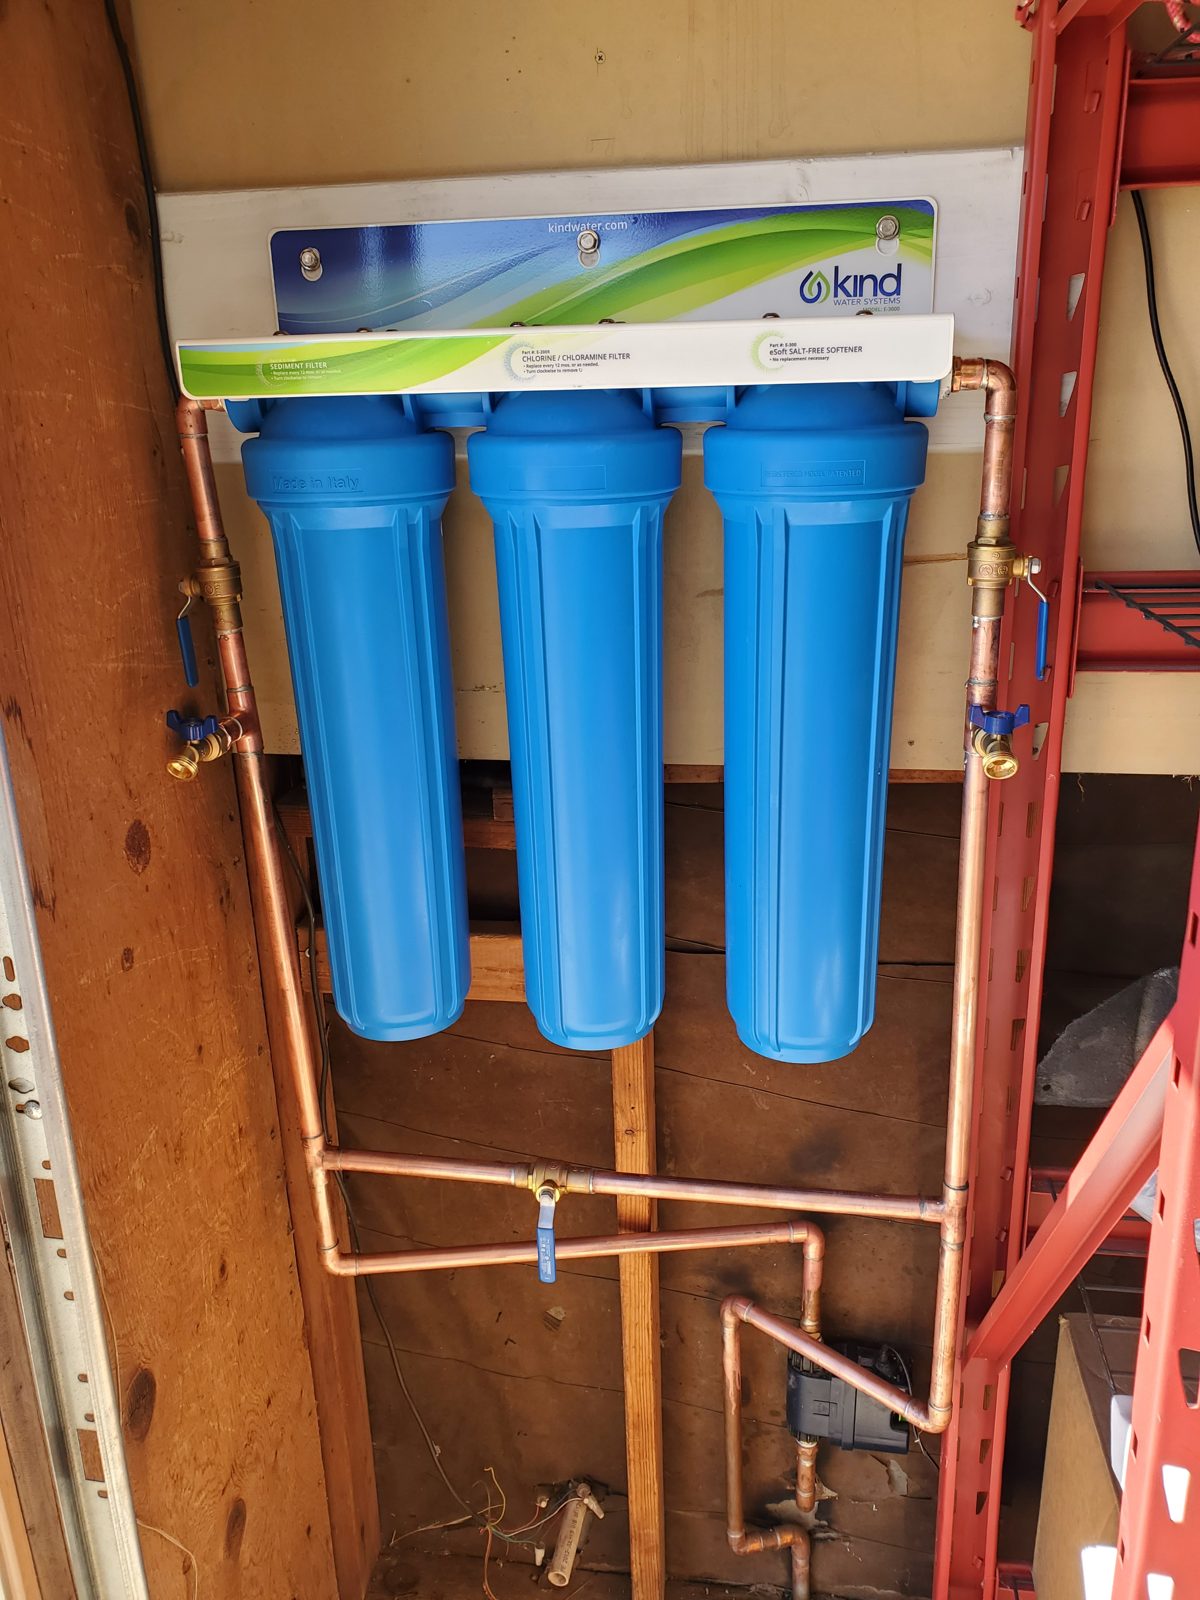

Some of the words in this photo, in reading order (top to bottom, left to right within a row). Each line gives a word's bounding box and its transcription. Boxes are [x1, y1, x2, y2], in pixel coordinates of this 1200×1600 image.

[548, 222, 628, 232] kindwater.com
[834, 263, 902, 298] kind
[272, 476, 306, 489] Made
[310, 476, 322, 489] in
[328, 475, 360, 490] Italy
